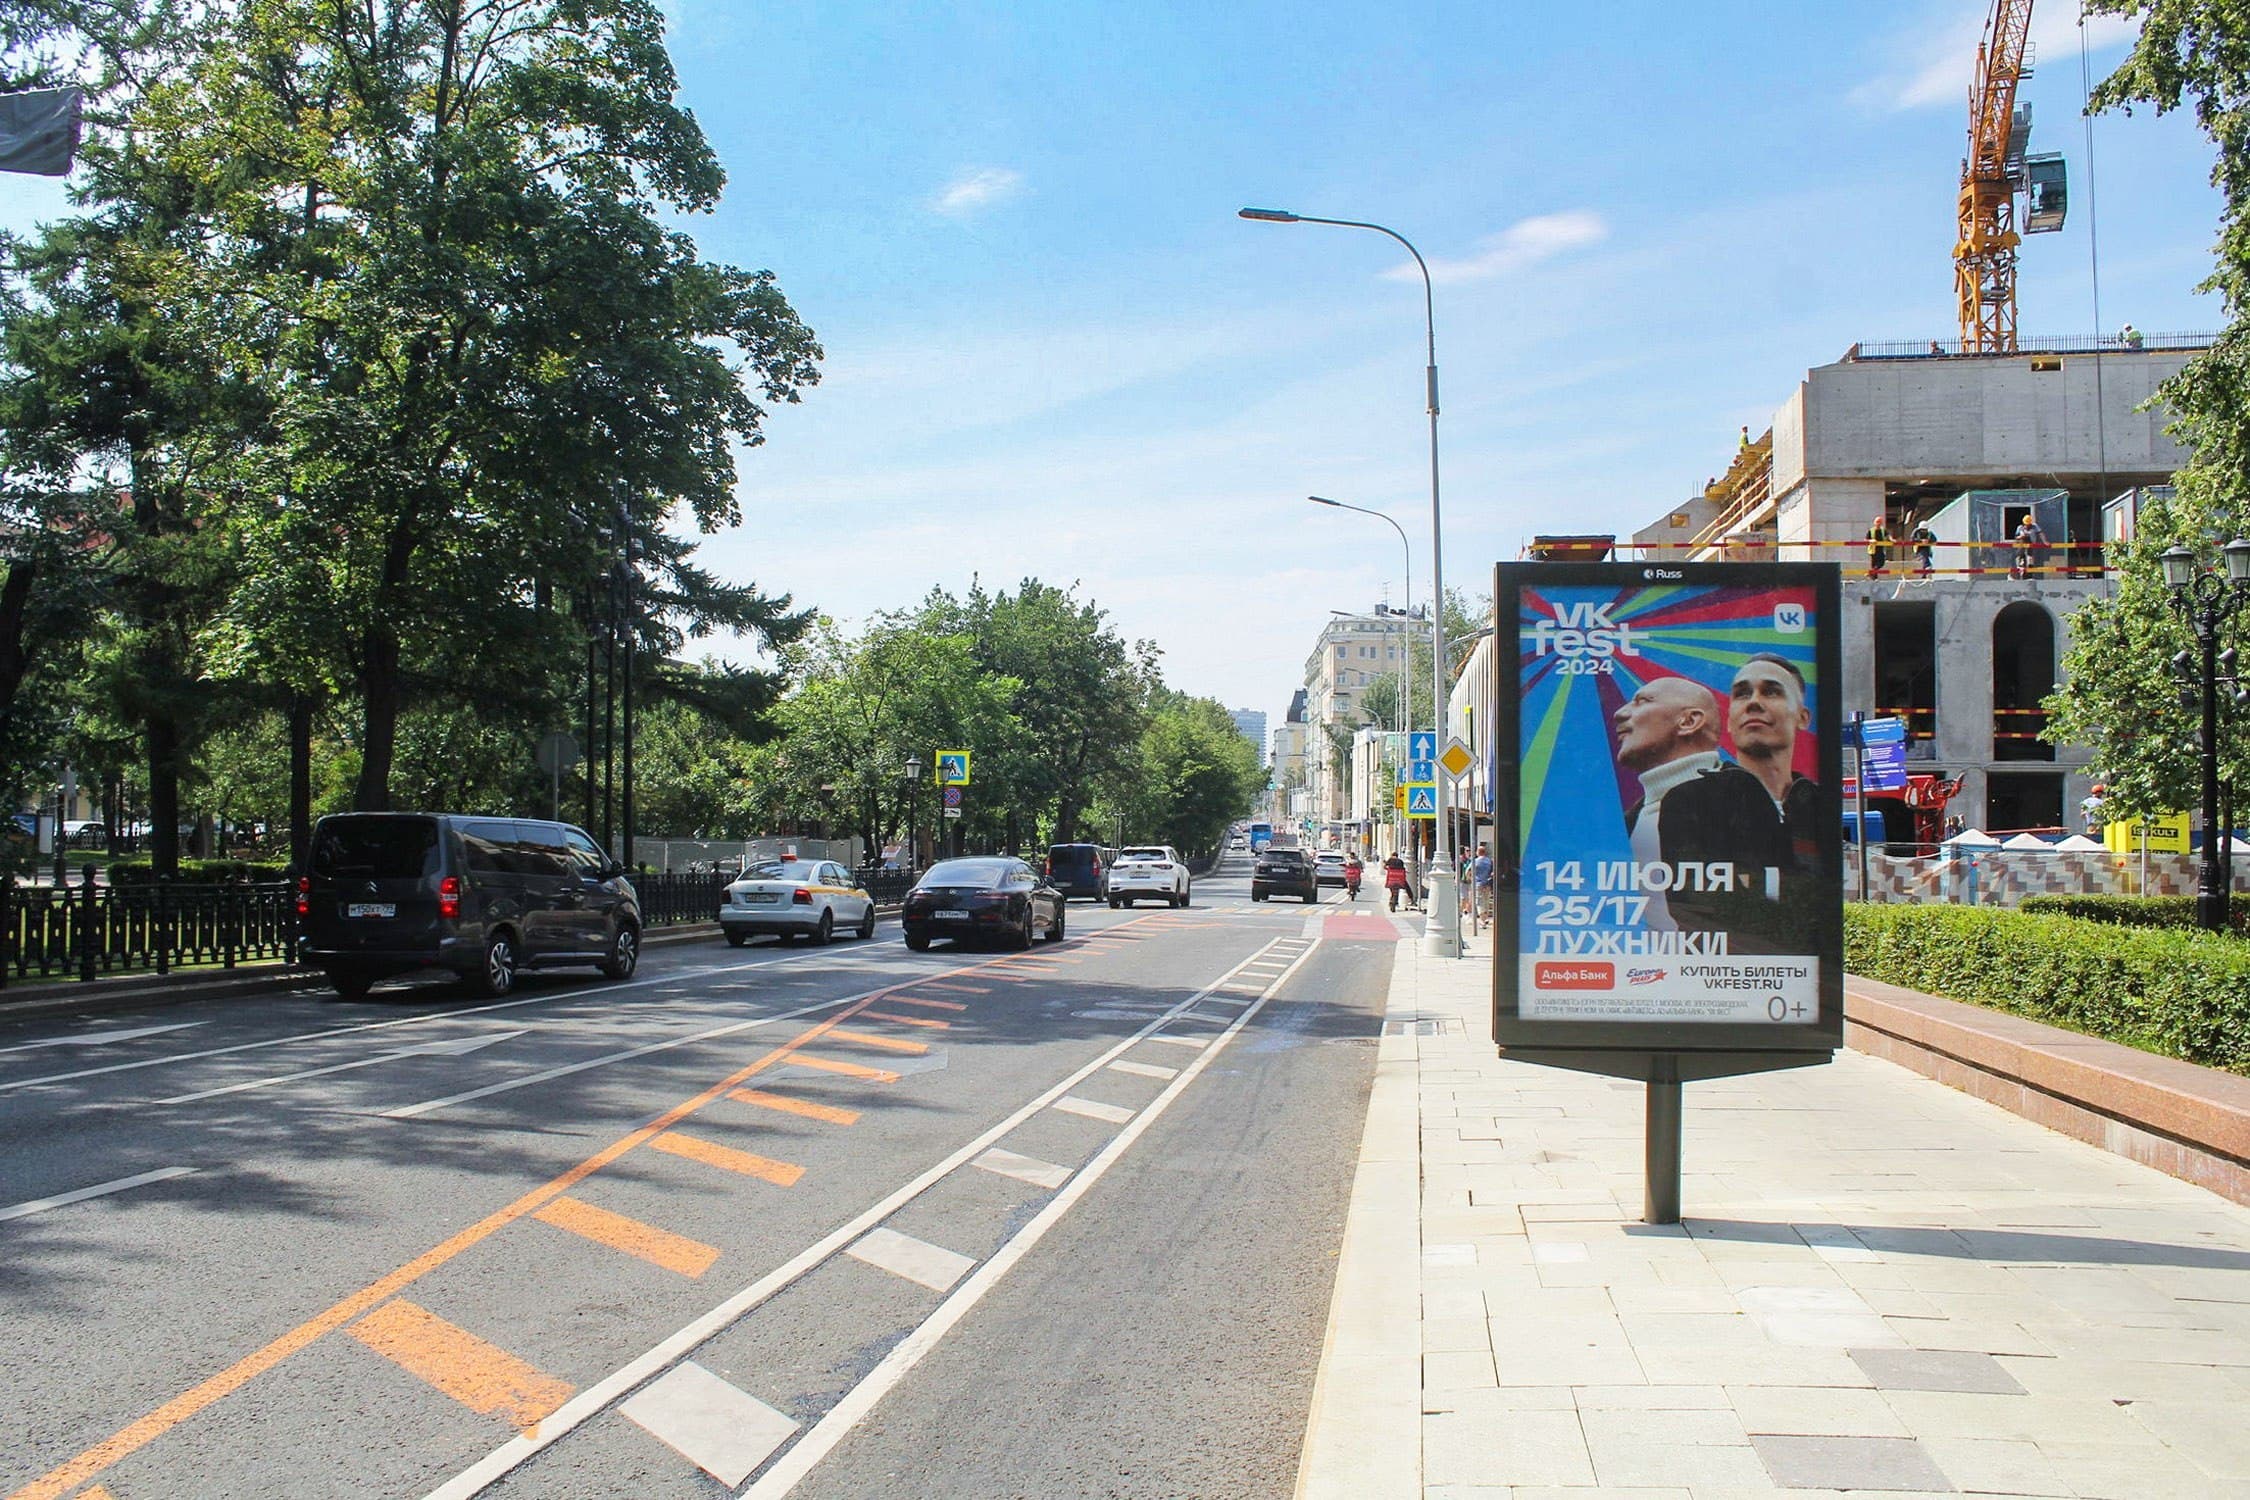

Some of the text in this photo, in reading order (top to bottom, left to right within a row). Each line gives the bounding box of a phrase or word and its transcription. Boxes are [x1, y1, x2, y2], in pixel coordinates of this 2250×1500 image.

[1655, 568, 1683, 579] Russ
[1552, 602, 1616, 628] VK
[1779, 612, 1800, 625] VK
[1532, 619, 1648, 657] fest
[1555, 658, 1615, 675] 2024
[1535, 860, 1734, 892] 14 ИЮЛЯ
[1535, 895, 1650, 926] 25/17
[1535, 930, 1728, 956] ЛУЖНИКИ
[1541, 969, 1608, 983] Альфа Банк
[1680, 966, 1808, 978] КУПИТЬ БИЛЕТЫ
[1704, 978, 1784, 990] VKFEST.RU
[1767, 996, 1808, 1022] 0+
